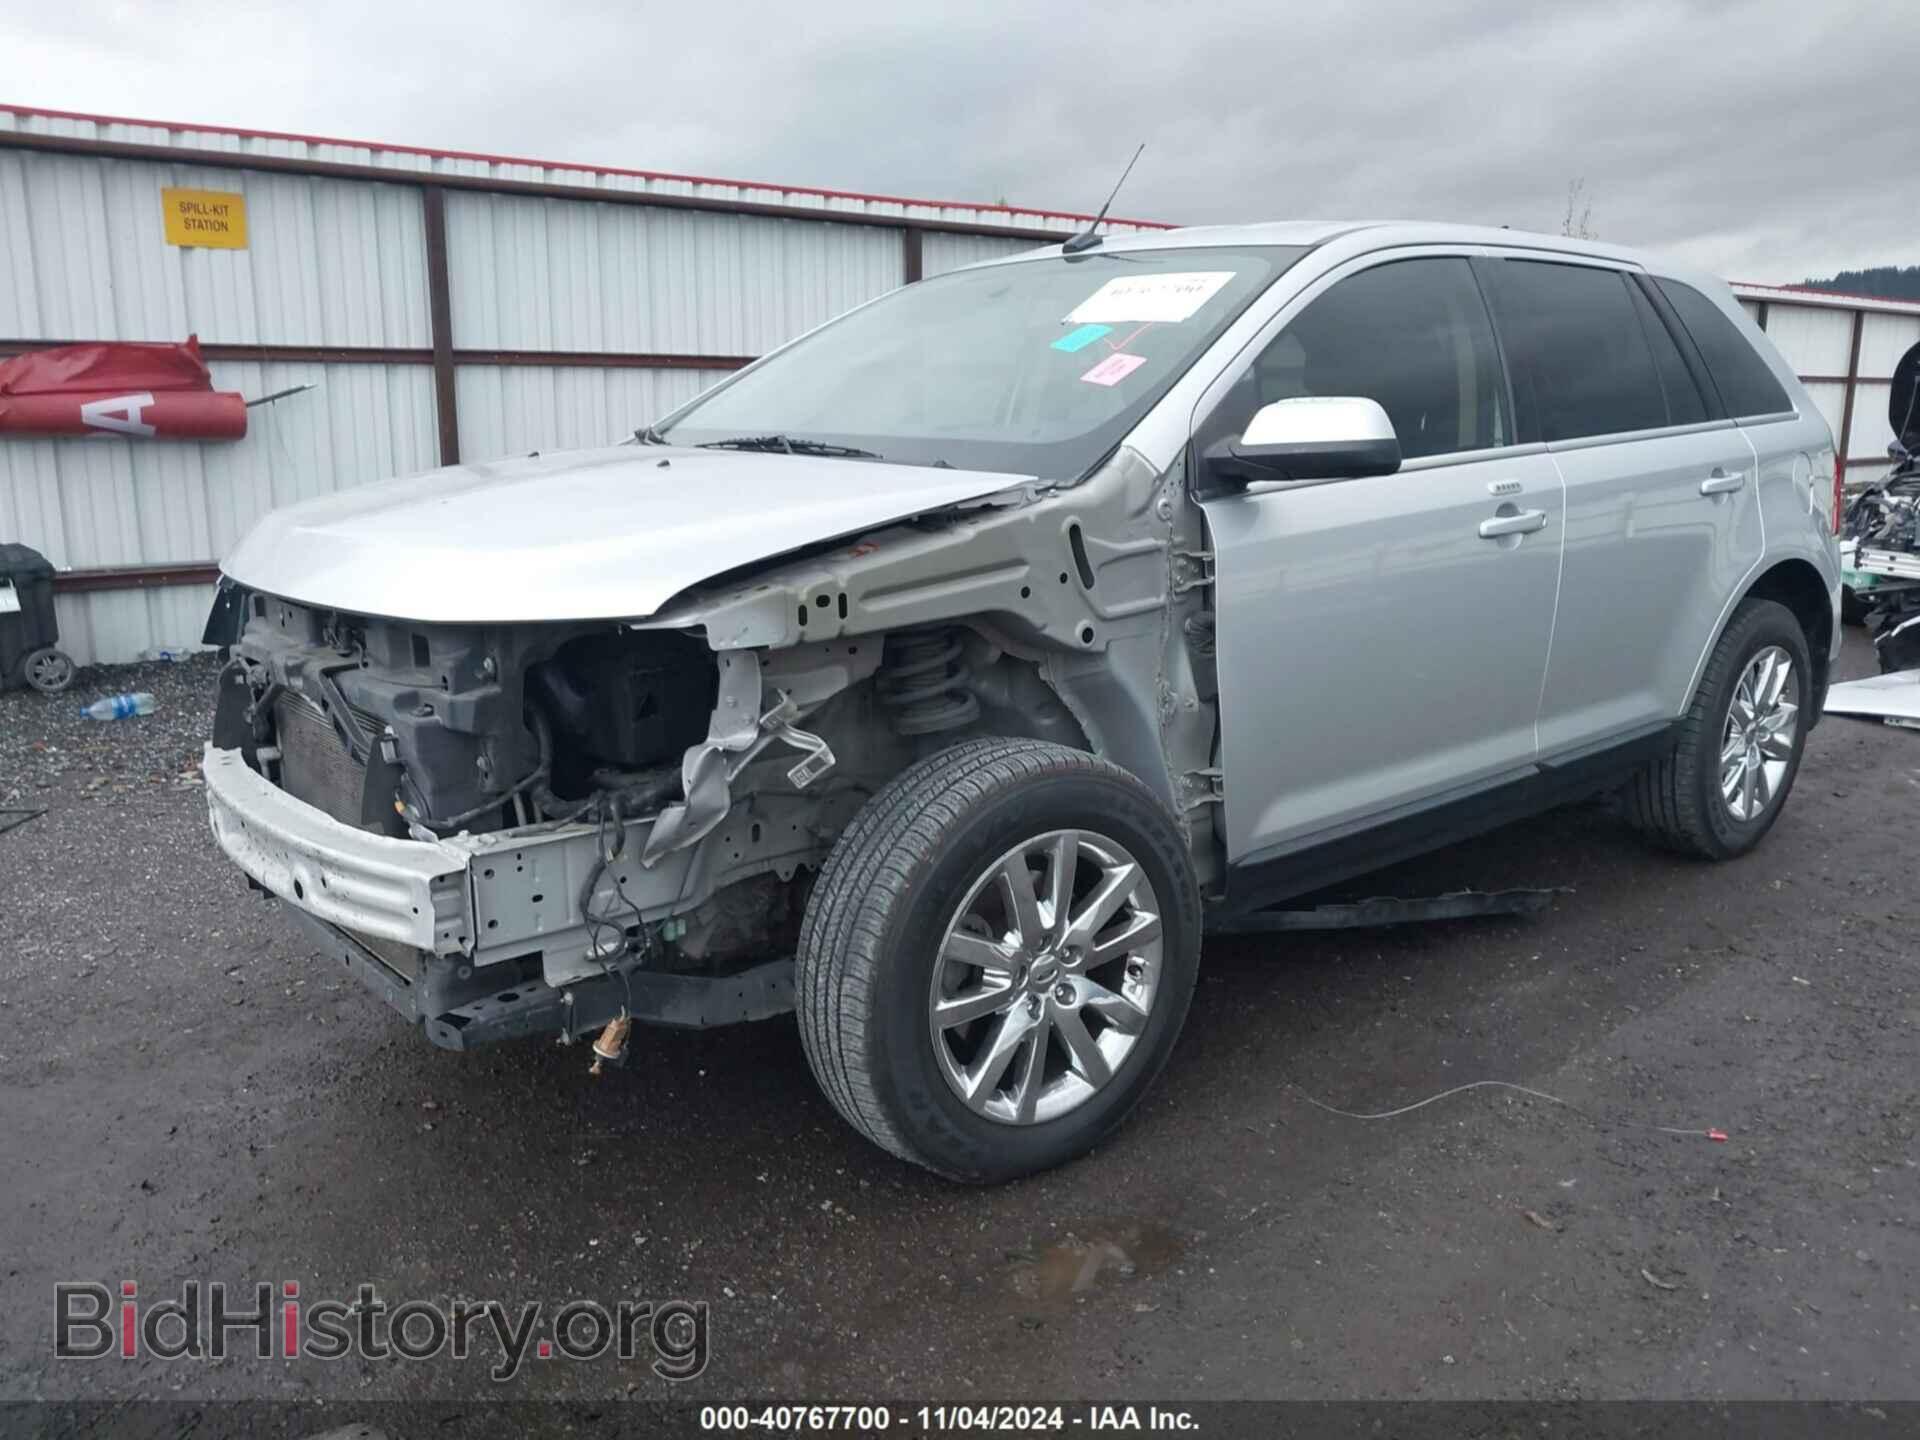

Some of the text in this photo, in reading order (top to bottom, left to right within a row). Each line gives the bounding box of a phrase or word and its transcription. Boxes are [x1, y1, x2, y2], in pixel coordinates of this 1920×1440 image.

[178, 201, 229, 217] SPILL-KIT
[183, 218, 229, 232] STATION
[81, 391, 155, 435] A
